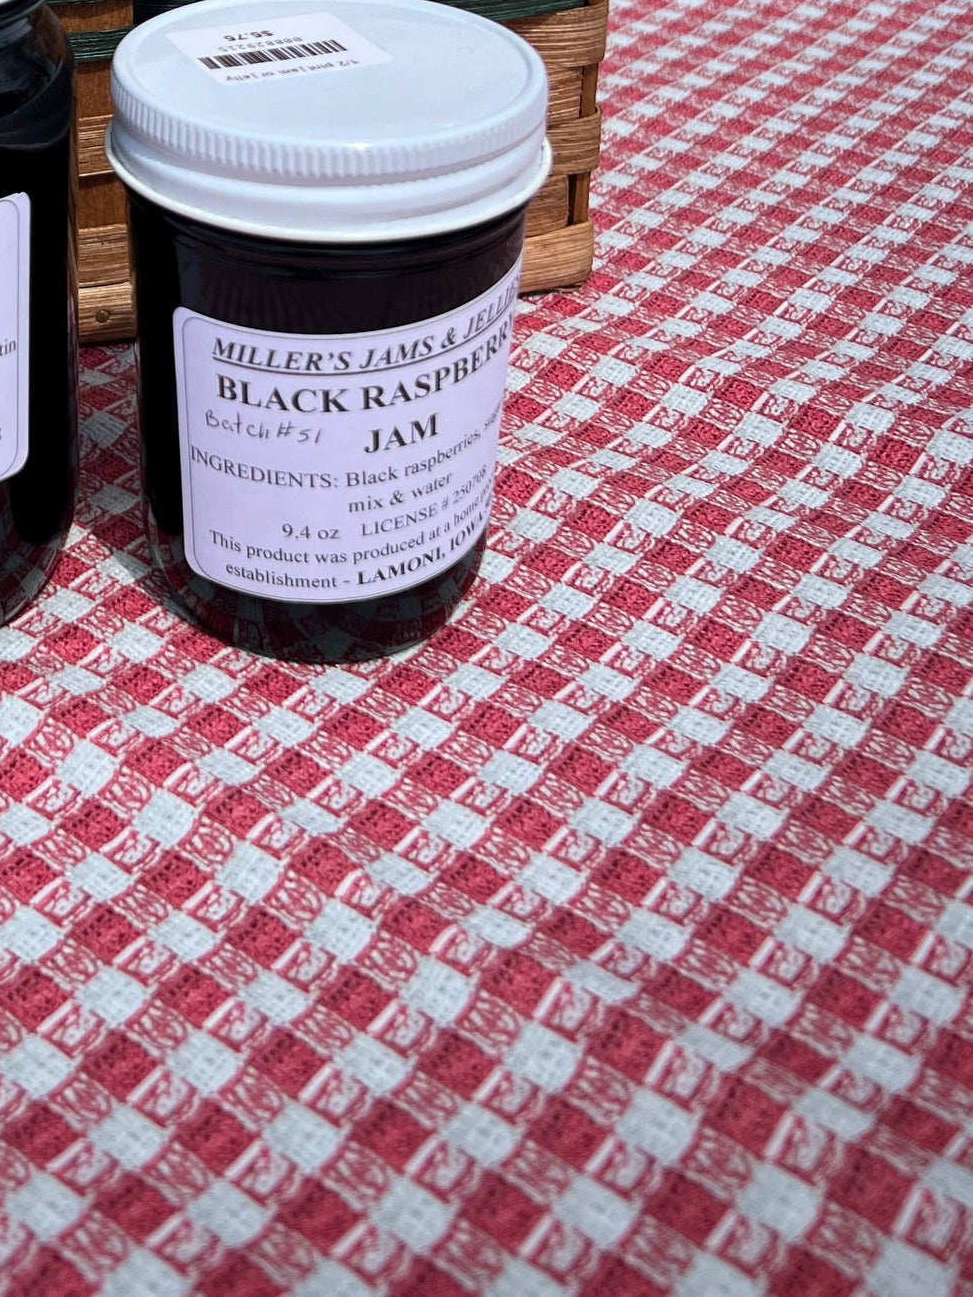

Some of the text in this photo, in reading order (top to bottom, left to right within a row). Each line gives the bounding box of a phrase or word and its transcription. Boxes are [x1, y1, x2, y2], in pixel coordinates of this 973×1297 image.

[213, 336, 352, 372] MILLER'S
[359, 335, 435, 370] JAMS
[440, 327, 456, 349] &
[215, 372, 349, 414] BLACK
[363, 411, 439, 454] JAM
[188, 444, 338, 489] INGREDIENTS:
[346, 466, 399, 488] Black
[403, 430, 481, 480] raspberries,
[348, 472, 453, 514] mix & water
[281, 523, 311, 540] 9.4
[317, 528, 340, 540] oz
[361, 503, 439, 538] LICENSE
[441, 495, 450, 511] #
[209, 529, 242, 553] This
[246, 544, 310, 565] product
[314, 552, 347, 564] was
[353, 530, 425, 565] produced
[429, 525, 441, 542] at
[443, 520, 451, 533] a
[225, 562, 337, 589] establishment
[357, 543, 447, 586] LAMONI,
